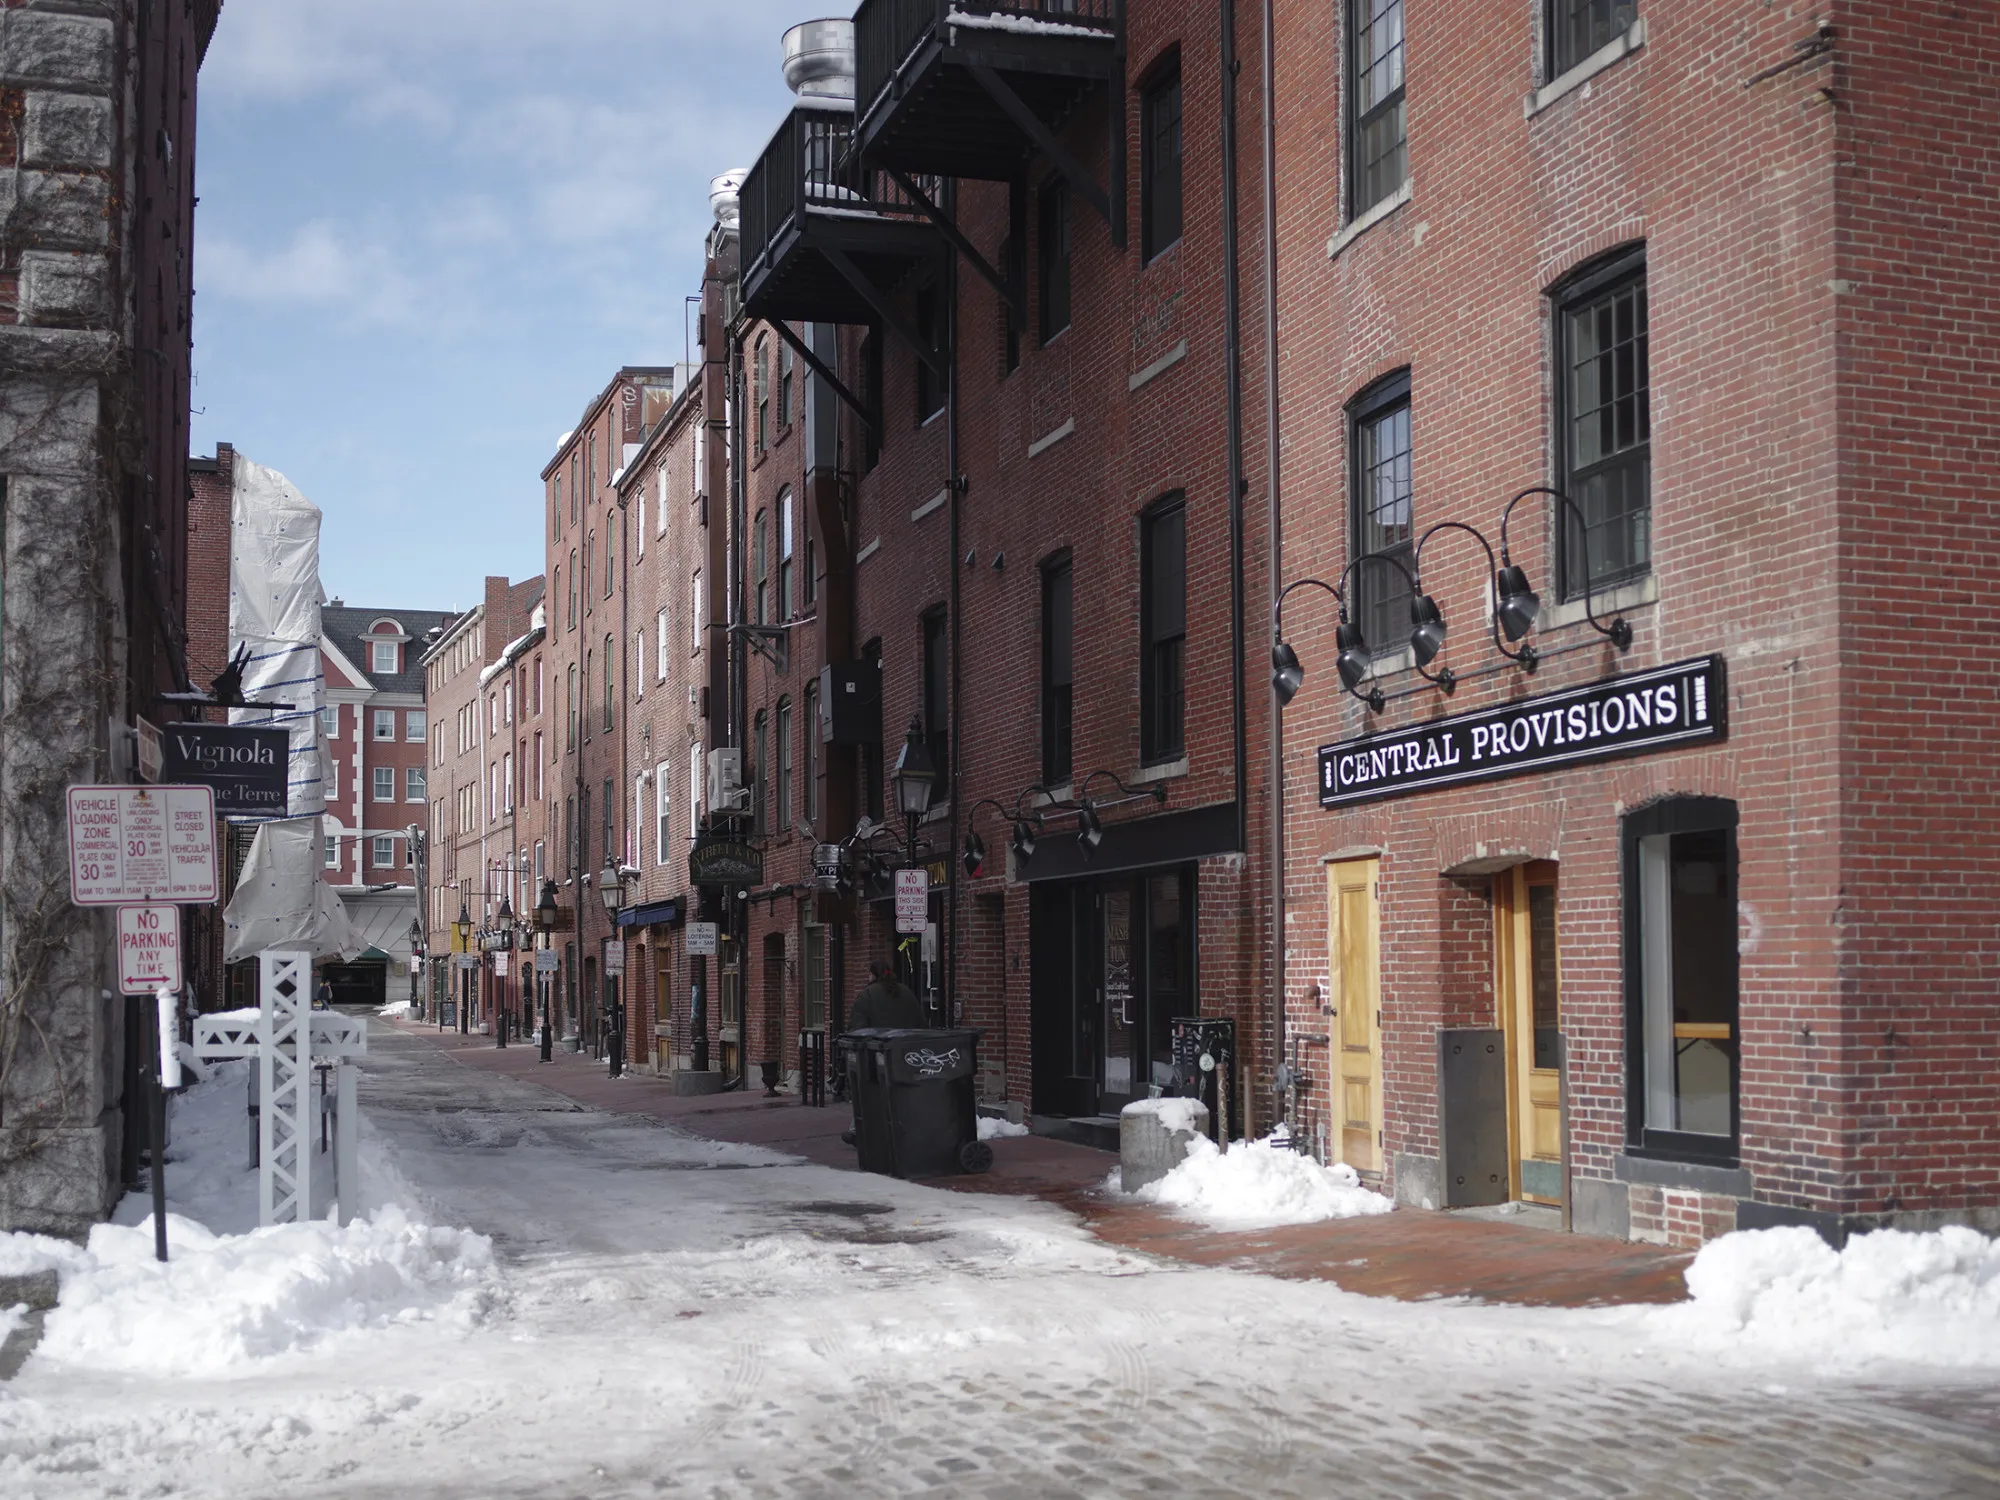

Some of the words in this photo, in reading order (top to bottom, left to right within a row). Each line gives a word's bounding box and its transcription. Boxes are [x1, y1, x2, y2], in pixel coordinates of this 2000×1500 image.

[1694, 675, 1707, 721] DRINK
[1339, 733, 1460, 785] CENTRAL
[1471, 684, 1677, 760] PROVISIONS
[176, 735, 275, 770] Vignola
[234, 784, 280, 802] Terre
[75, 799, 116, 811] VEHICLE
[74, 813, 118, 825] LOADING
[174, 811, 203, 820] STREET
[174, 822, 204, 831] CLOSED
[83, 827, 111, 838] ZONE
[185, 833, 195, 842] TO
[76, 841, 119, 850] COMMERCIAL
[128, 841, 146, 857] 30
[170, 844, 211, 853] VEHICULAR
[79, 853, 98, 861] PLATE
[101, 852, 117, 861] ONLY
[176, 855, 206, 864] TRAFFIC
[80, 864, 99, 880] 30
[928, 861, 946, 885] TUN
[905, 875, 917, 884] NO
[95, 887, 104, 895] TO
[143, 886, 153, 894] TO
[189, 884, 197, 892] TO
[898, 886, 925, 895] PARKING
[137, 913, 159, 929] NO
[123, 932, 175, 949] PARKING
[138, 950, 160, 961] ANY
[136, 963, 164, 974] TIME
